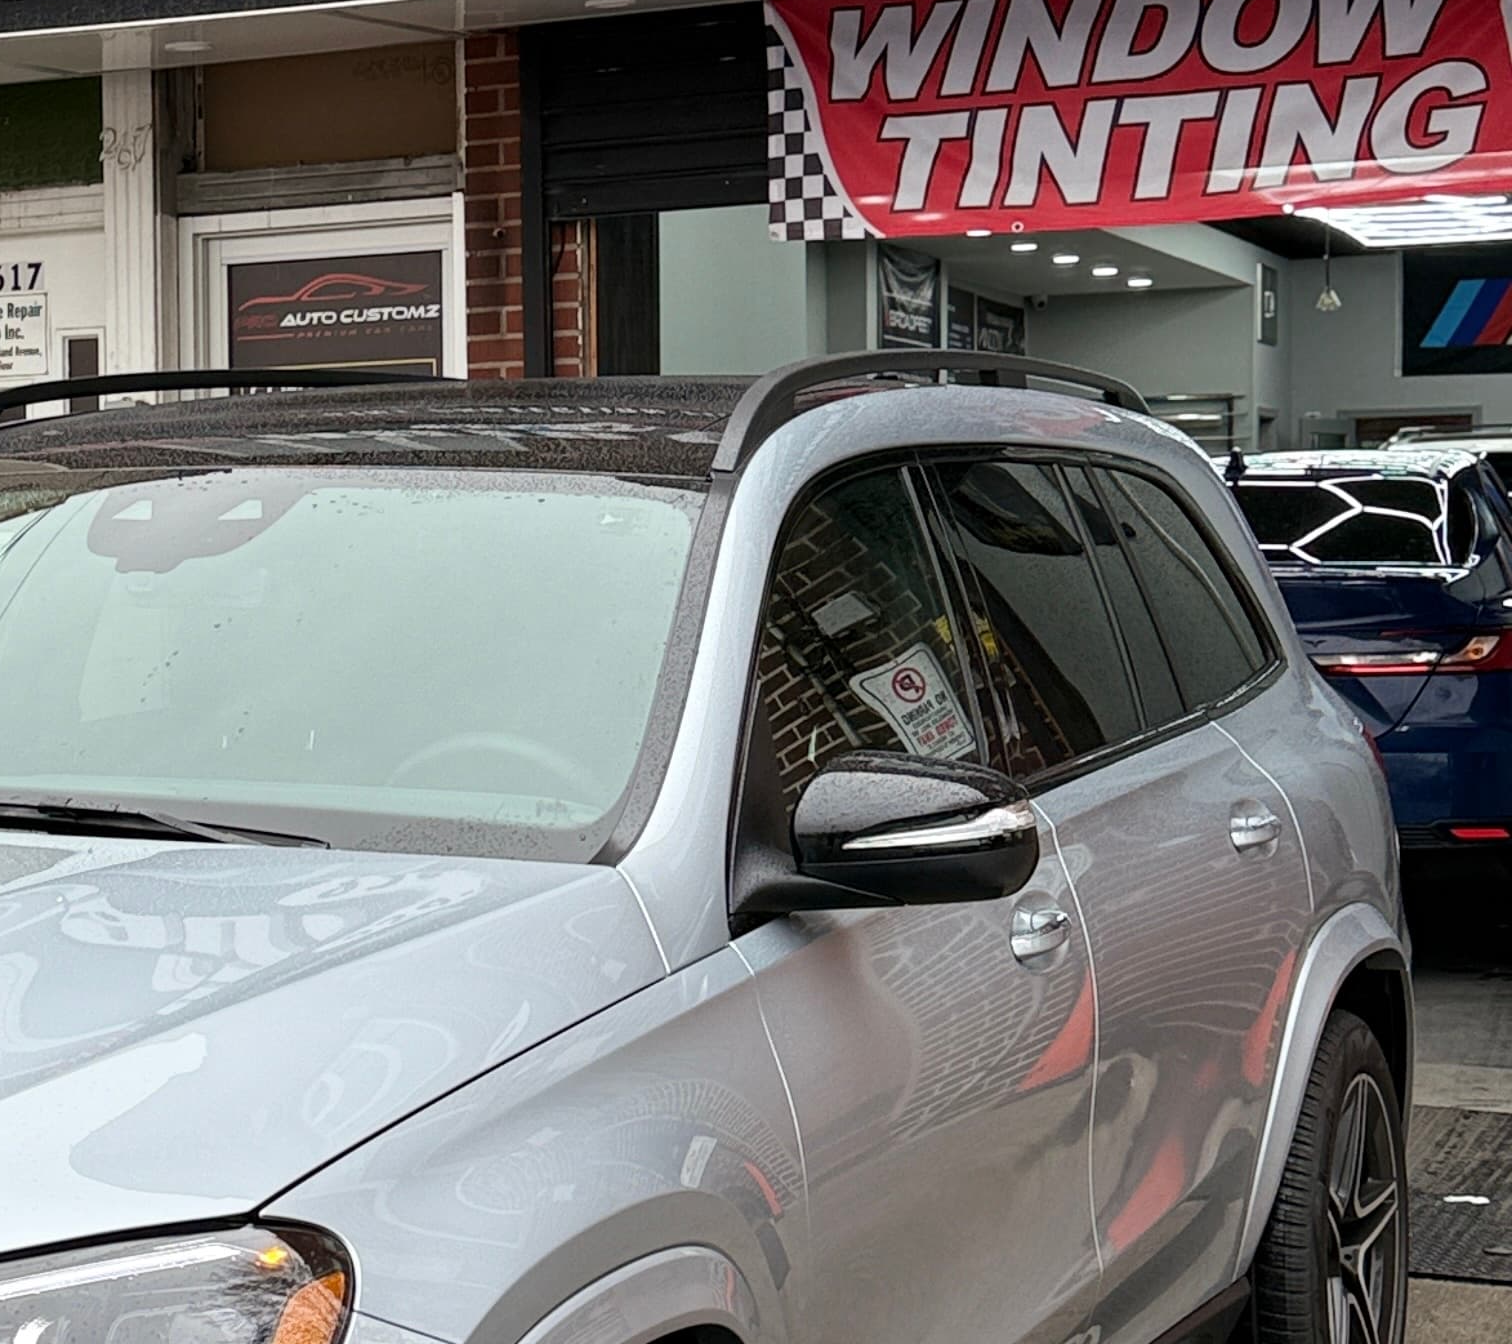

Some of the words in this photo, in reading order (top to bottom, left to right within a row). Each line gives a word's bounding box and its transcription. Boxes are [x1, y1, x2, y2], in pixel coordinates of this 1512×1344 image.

[879, 59, 1488, 212] TINTING
[7, 301, 42, 320] Repair
[280, 310, 337, 327] AUTO
[340, 304, 440, 323] CUSTOMZ
